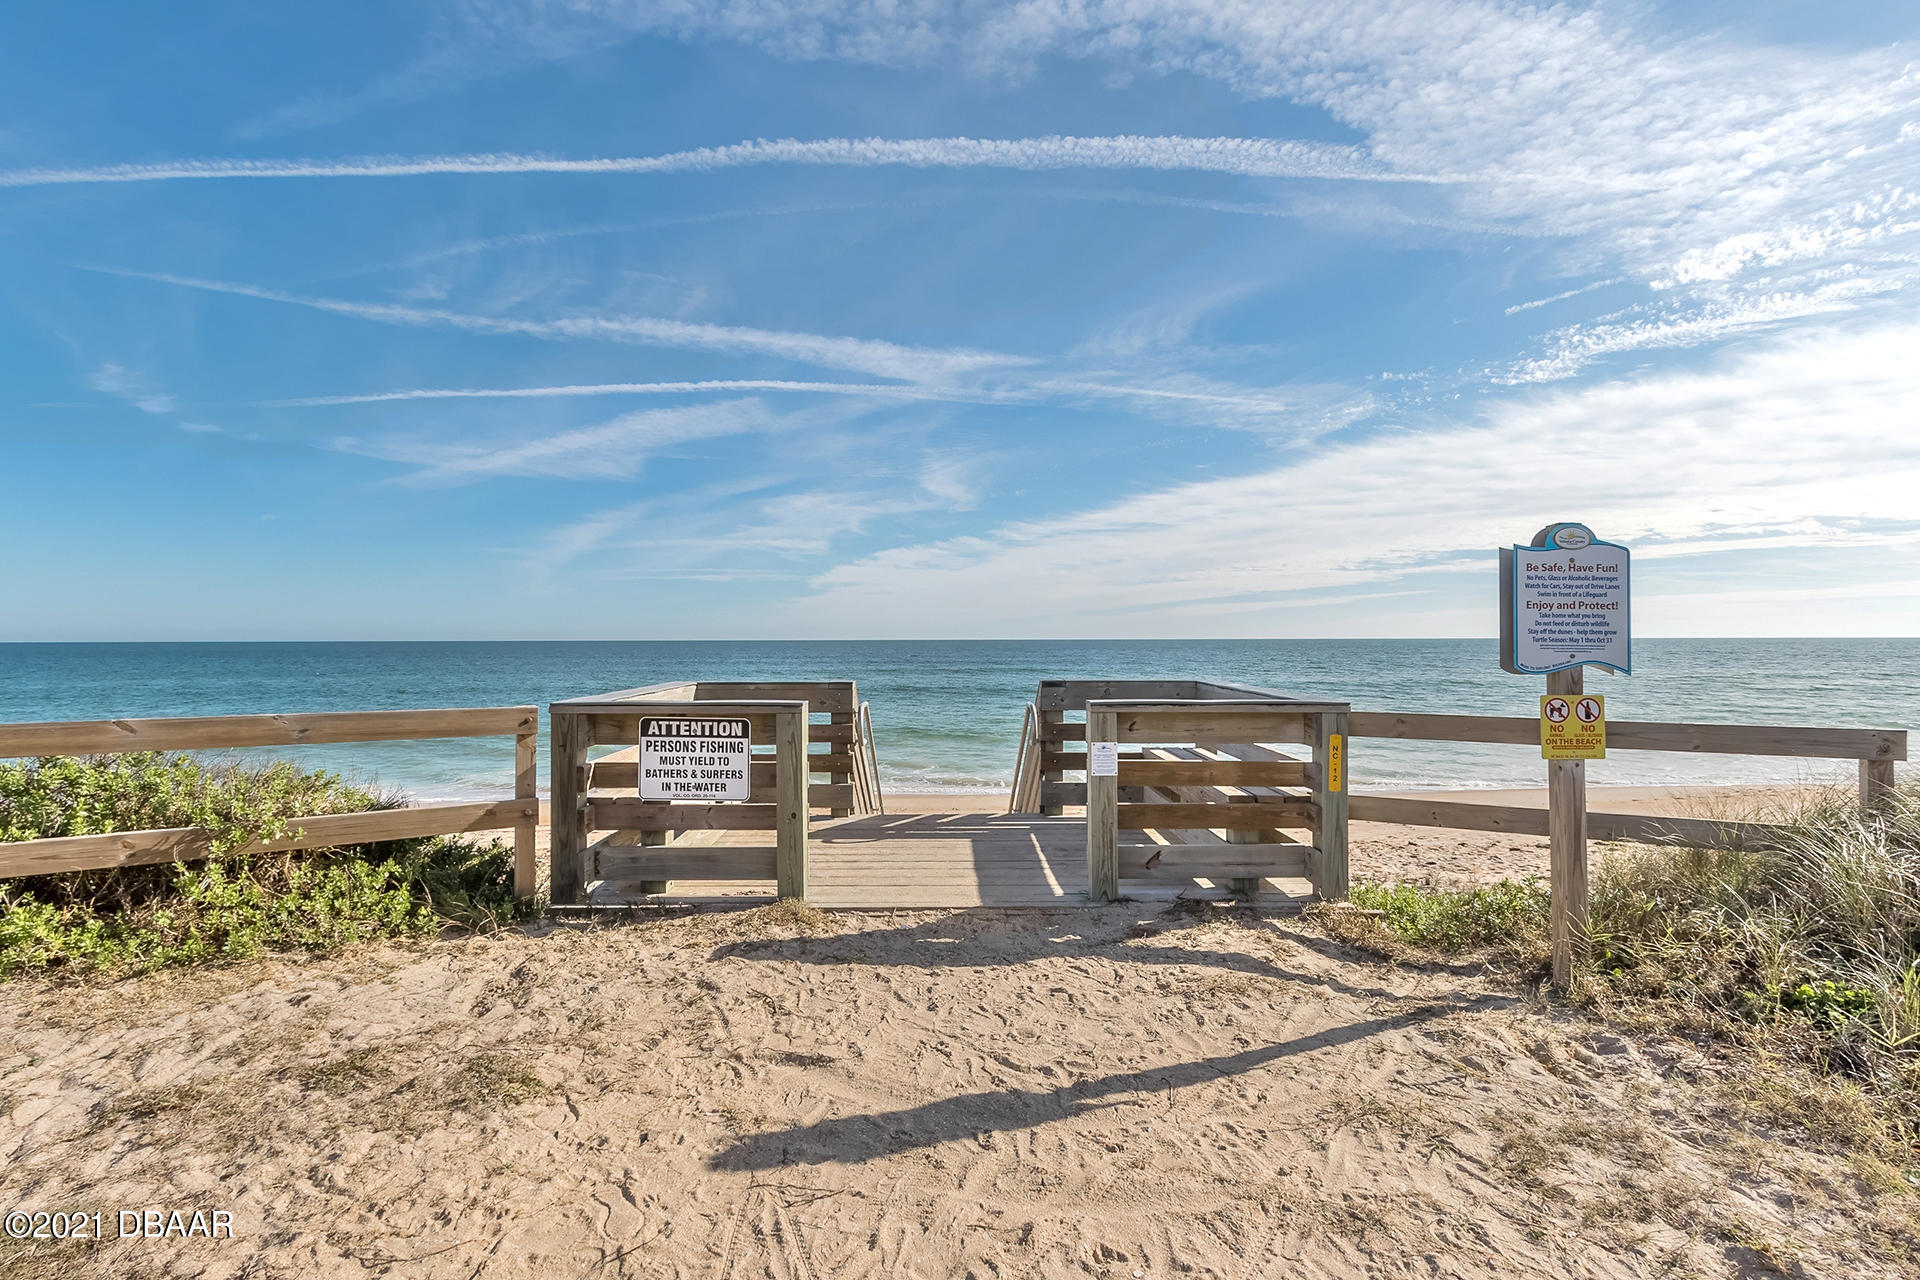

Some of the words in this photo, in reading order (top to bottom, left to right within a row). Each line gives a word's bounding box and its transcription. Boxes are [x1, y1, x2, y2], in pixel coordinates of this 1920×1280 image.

[1526, 563, 1539, 572] Be
[1542, 563, 1566, 573] Safe,
[1568, 564, 1594, 572] Have
[1596, 564, 1618, 572] Fun!
[1526, 601, 1554, 611] Enjoy
[1556, 601, 1576, 610] and
[1578, 602, 1618, 610] Protect!
[648, 721, 742, 736] ATTENTION
[646, 740, 696, 752] PERSONS
[700, 741, 744, 753] FISHING
[660, 756, 686, 765] MUST
[689, 757, 715, 766] YIELD
[717, 757, 729, 766] TO
[646, 769, 688, 778] BATHERS
[691, 770, 697, 778] &
[700, 770, 743, 779] SURFERS
[662, 782, 671, 791] IN
[674, 783, 693, 791] THE
[695, 783, 727, 792] WATER
